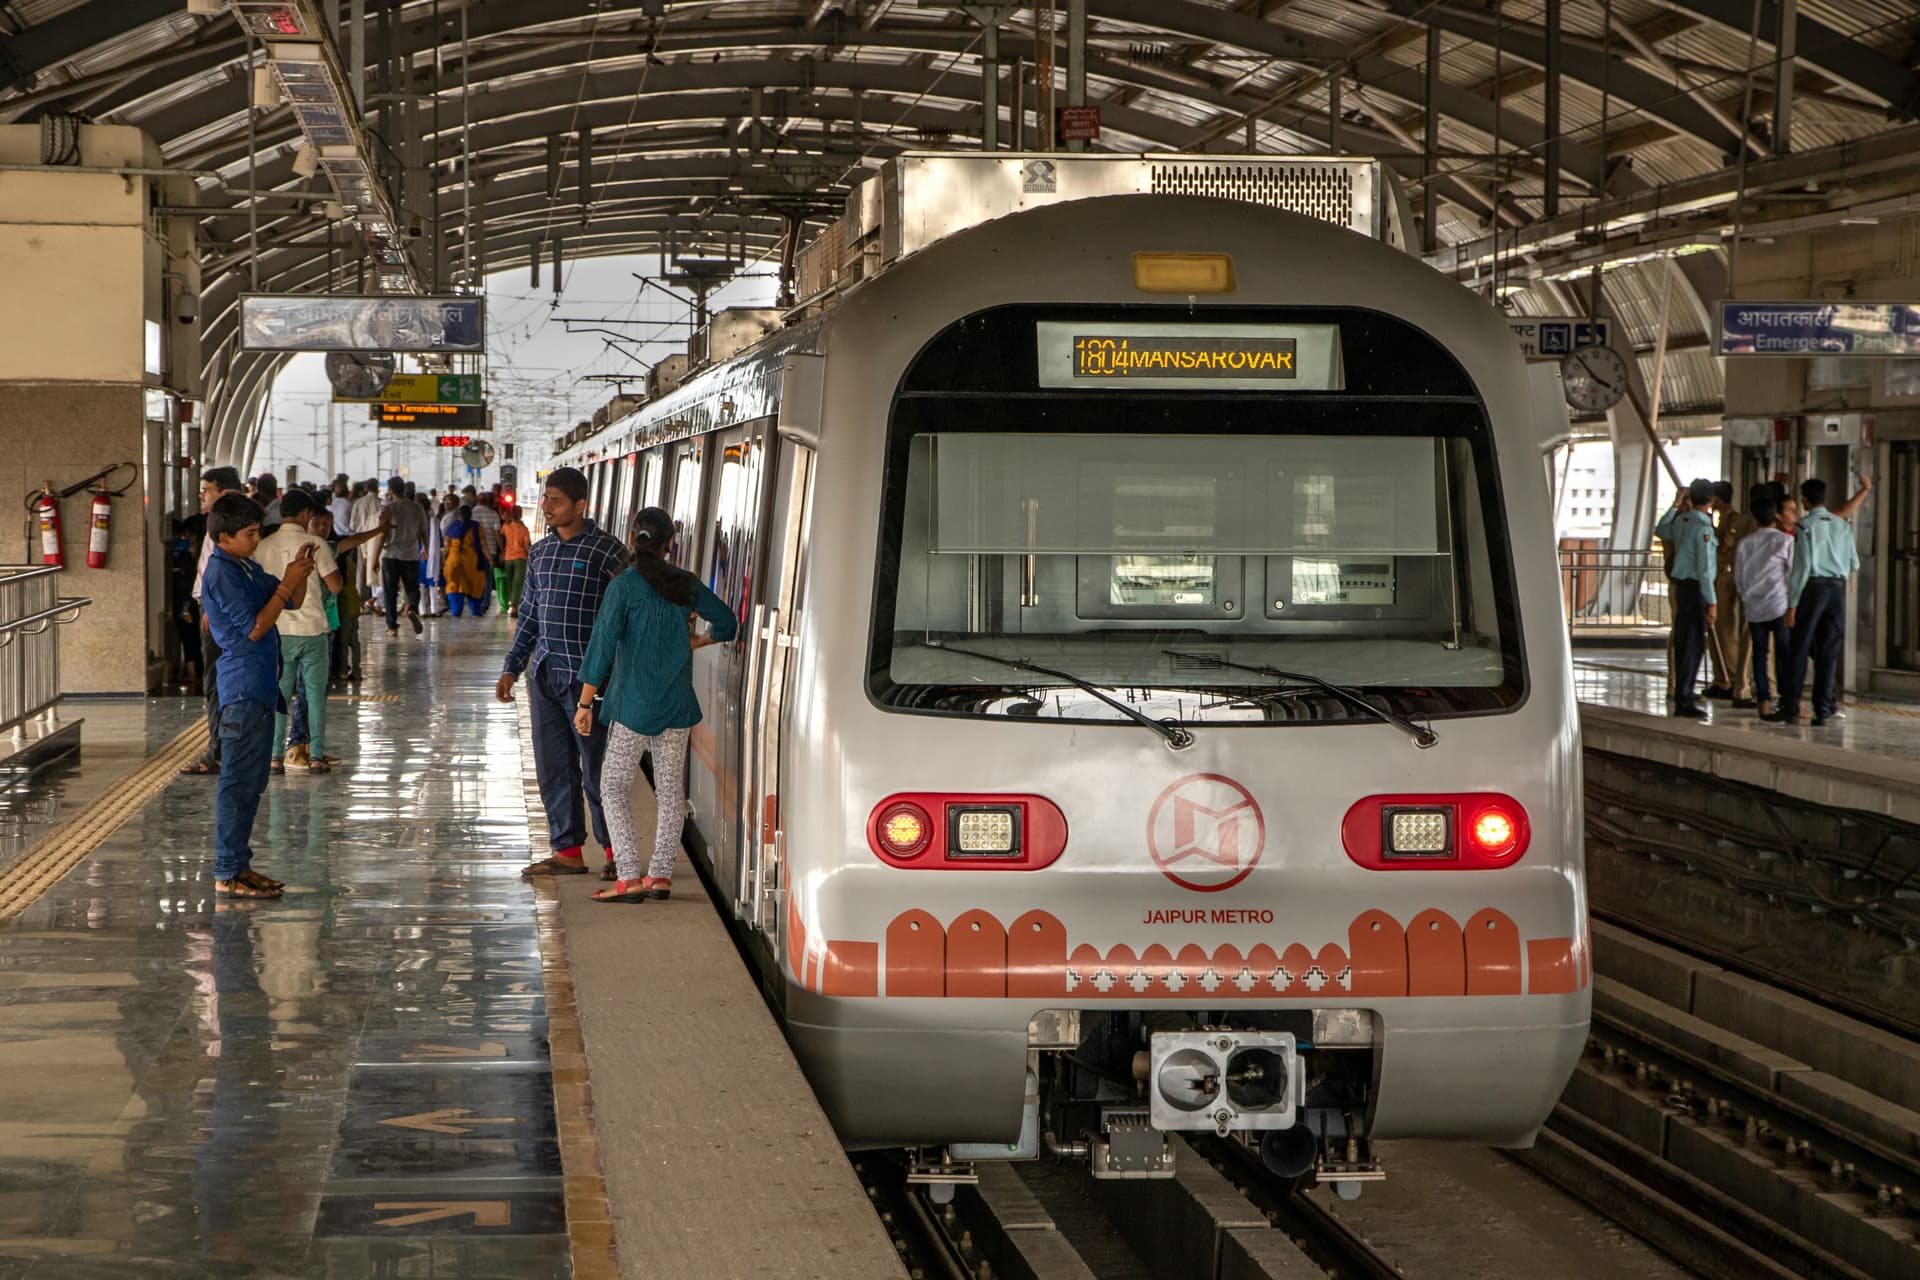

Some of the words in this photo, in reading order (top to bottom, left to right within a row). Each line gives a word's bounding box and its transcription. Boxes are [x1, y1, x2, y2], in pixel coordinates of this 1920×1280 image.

[1075, 339, 1129, 374] 1804
[1130, 351, 1292, 370] MANSAROVAR
[1143, 909, 1207, 924] JAIPUR
[1211, 909, 1274, 924] METRO
